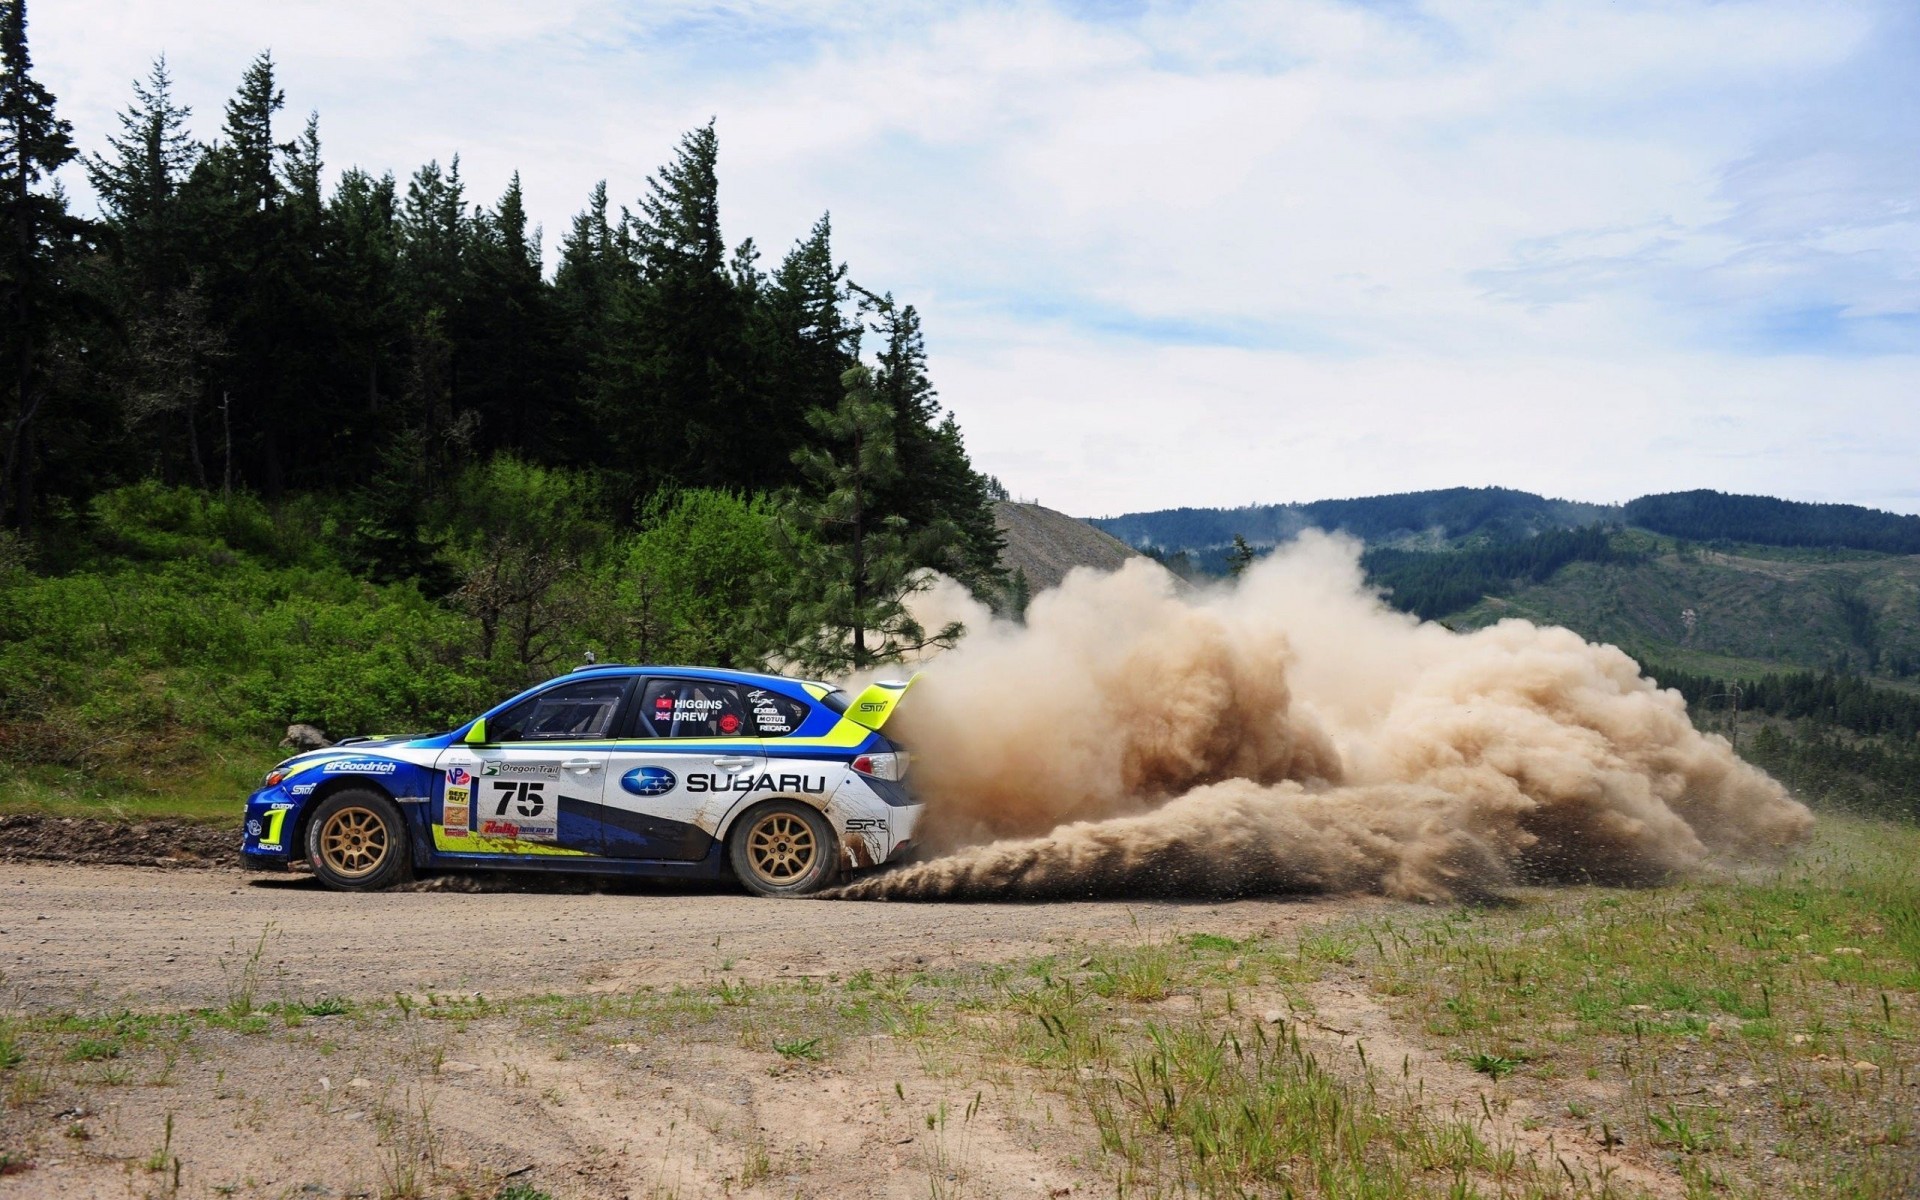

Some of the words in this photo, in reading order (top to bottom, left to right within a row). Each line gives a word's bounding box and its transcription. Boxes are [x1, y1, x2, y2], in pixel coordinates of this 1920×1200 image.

[674, 700, 722, 710] HIGGINS
[673, 712, 708, 721] DREW
[324, 761, 396, 773] BFGoodrich
[502, 764, 536, 774] Oregon
[539, 765, 559, 774] Trail
[448, 768, 464, 785] VP
[685, 773, 825, 793] SUBARU
[449, 790, 468, 798] BEST
[493, 782, 544, 817] 75
[483, 820, 519, 837] Rally
[258, 843, 283, 851] RECARO
